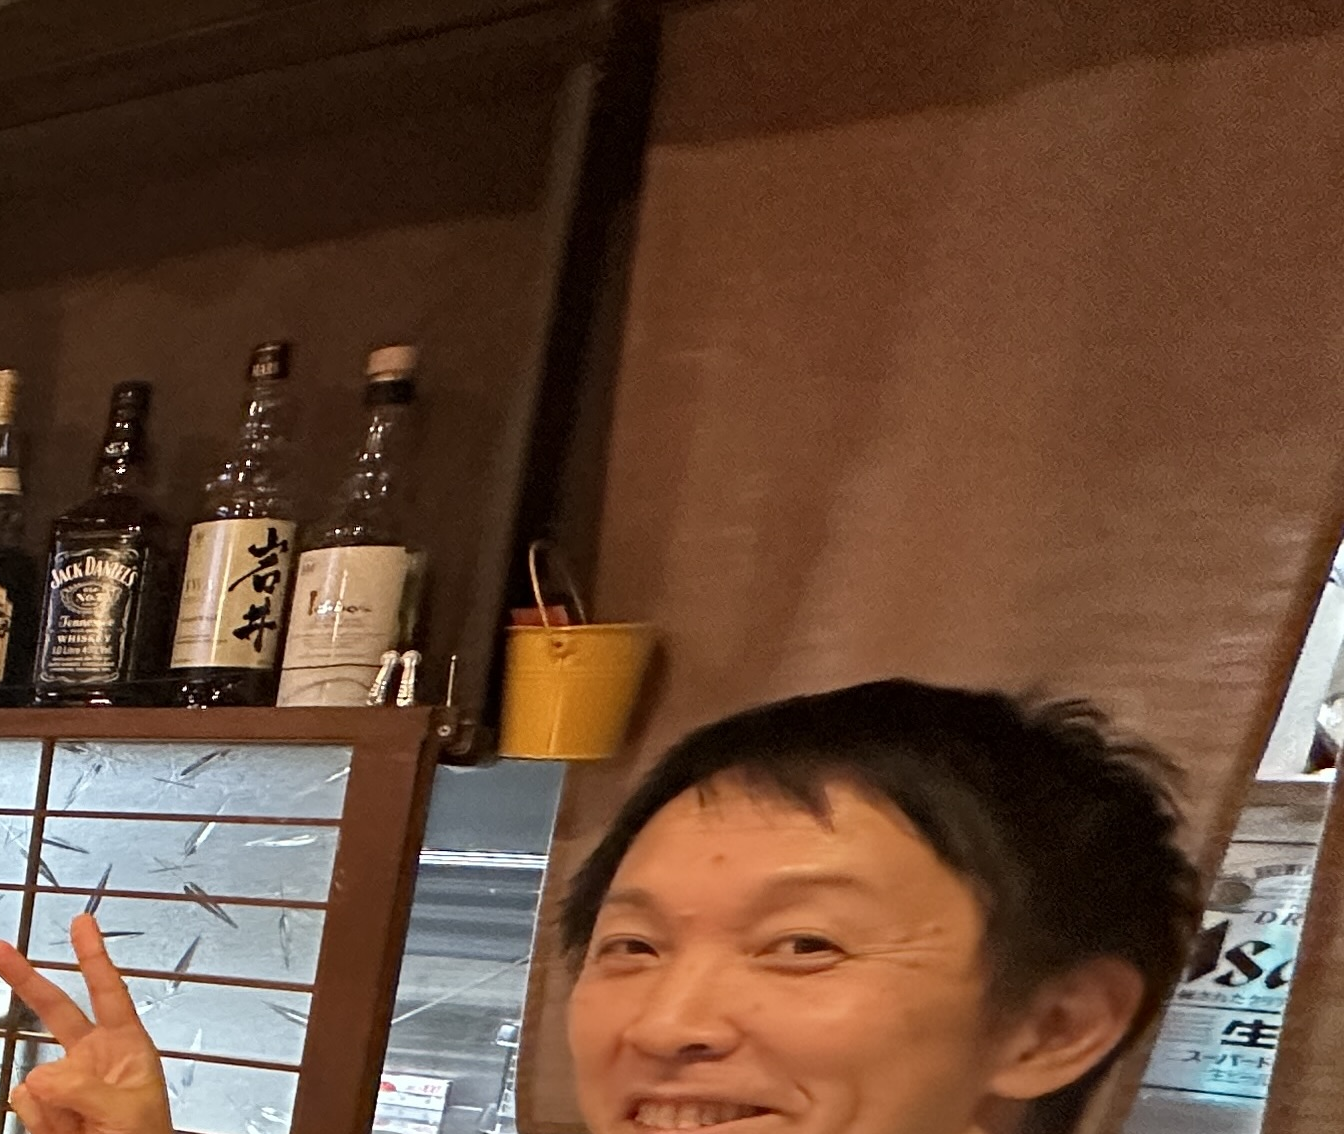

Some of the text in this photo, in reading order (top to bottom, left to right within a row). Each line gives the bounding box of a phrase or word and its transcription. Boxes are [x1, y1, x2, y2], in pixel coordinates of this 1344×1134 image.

[50, 560, 83, 589] JACK
[227, 527, 289, 653] 岩井
[1219, 1019, 1280, 1050] 生
